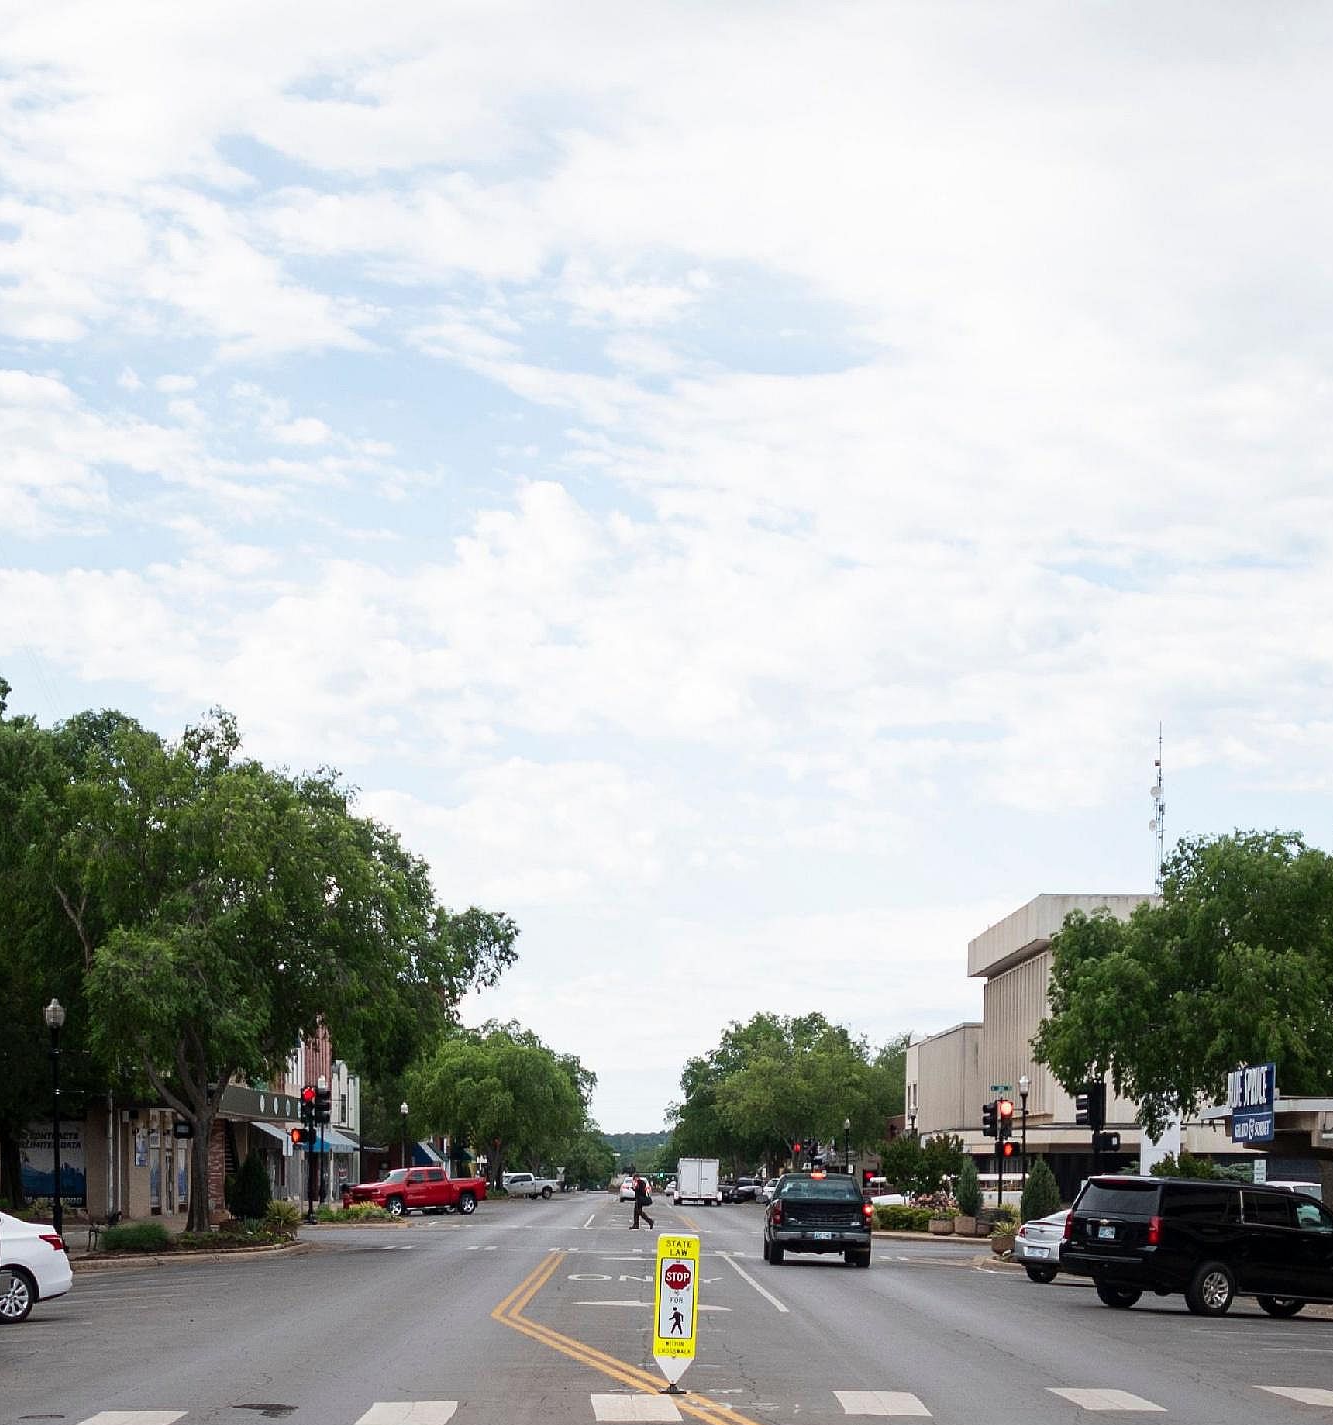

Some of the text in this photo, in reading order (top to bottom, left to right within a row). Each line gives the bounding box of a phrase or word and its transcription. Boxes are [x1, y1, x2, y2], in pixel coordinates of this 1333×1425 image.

[666, 1240, 692, 1248] STATE
[670, 1249, 688, 1257] LAW
[665, 1272, 690, 1281] STOP
